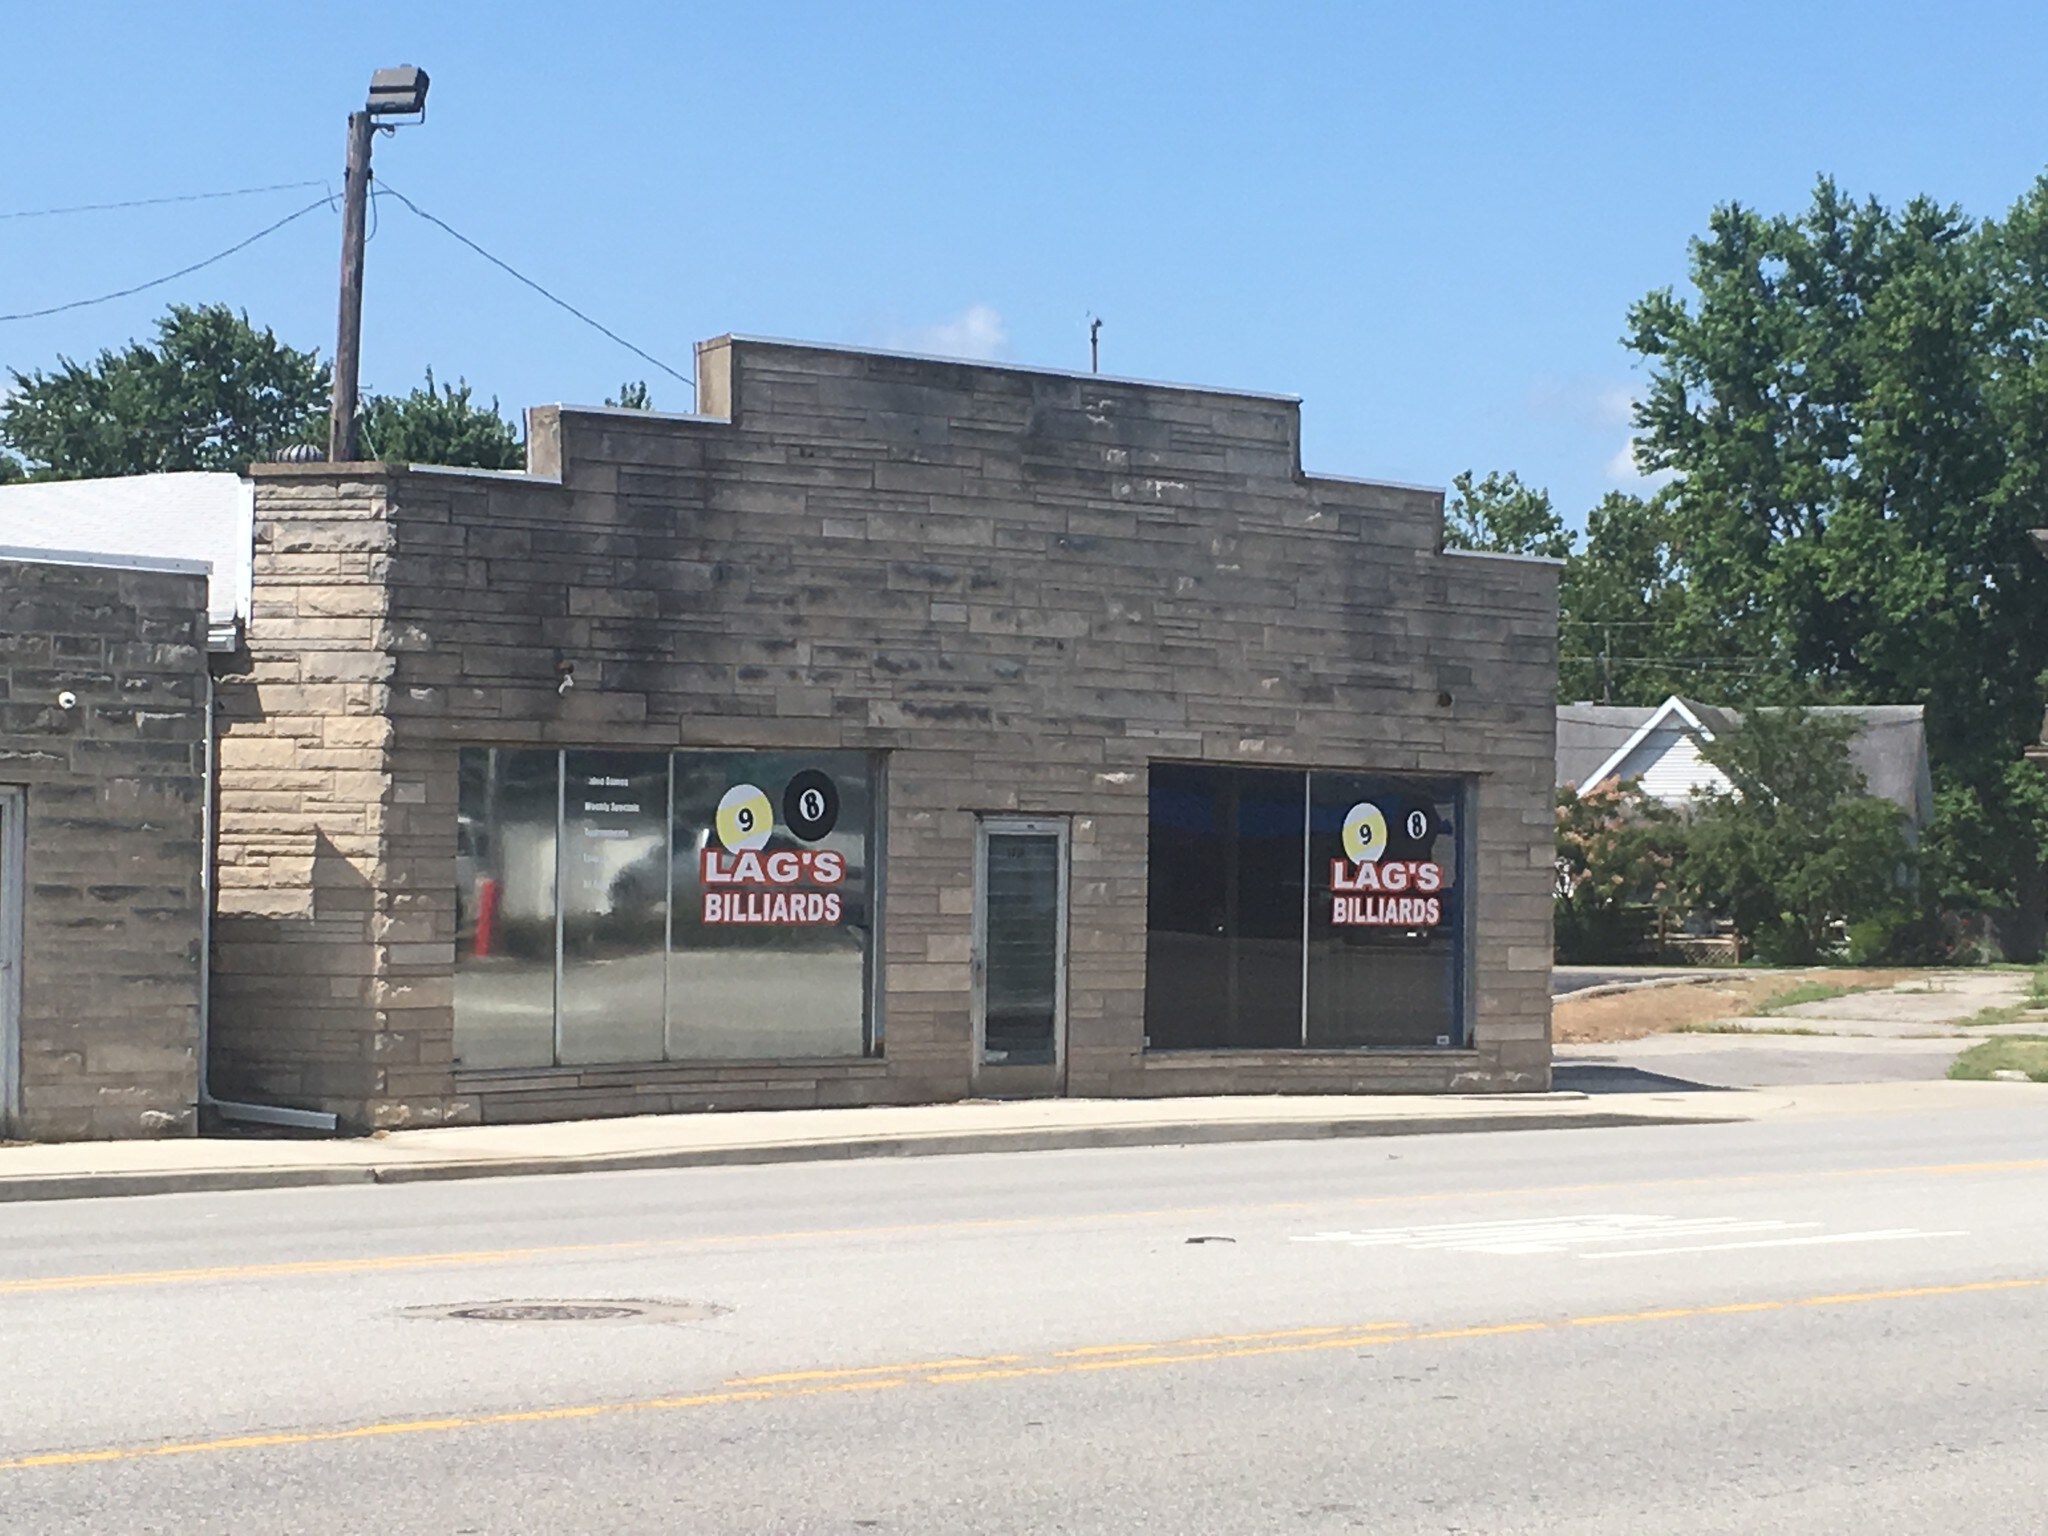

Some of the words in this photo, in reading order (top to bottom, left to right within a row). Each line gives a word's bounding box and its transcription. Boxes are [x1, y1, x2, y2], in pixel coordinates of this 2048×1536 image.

[804, 792, 819, 818] 8
[738, 808, 754, 832] 9
[1411, 814, 1423, 836] 8
[1359, 824, 1372, 845] 9
[703, 850, 843, 884] LAG'S
[1332, 860, 1441, 891] LAG'S
[704, 892, 841, 923] BILLIARDS
[1332, 896, 1440, 924] BILLIARDS
